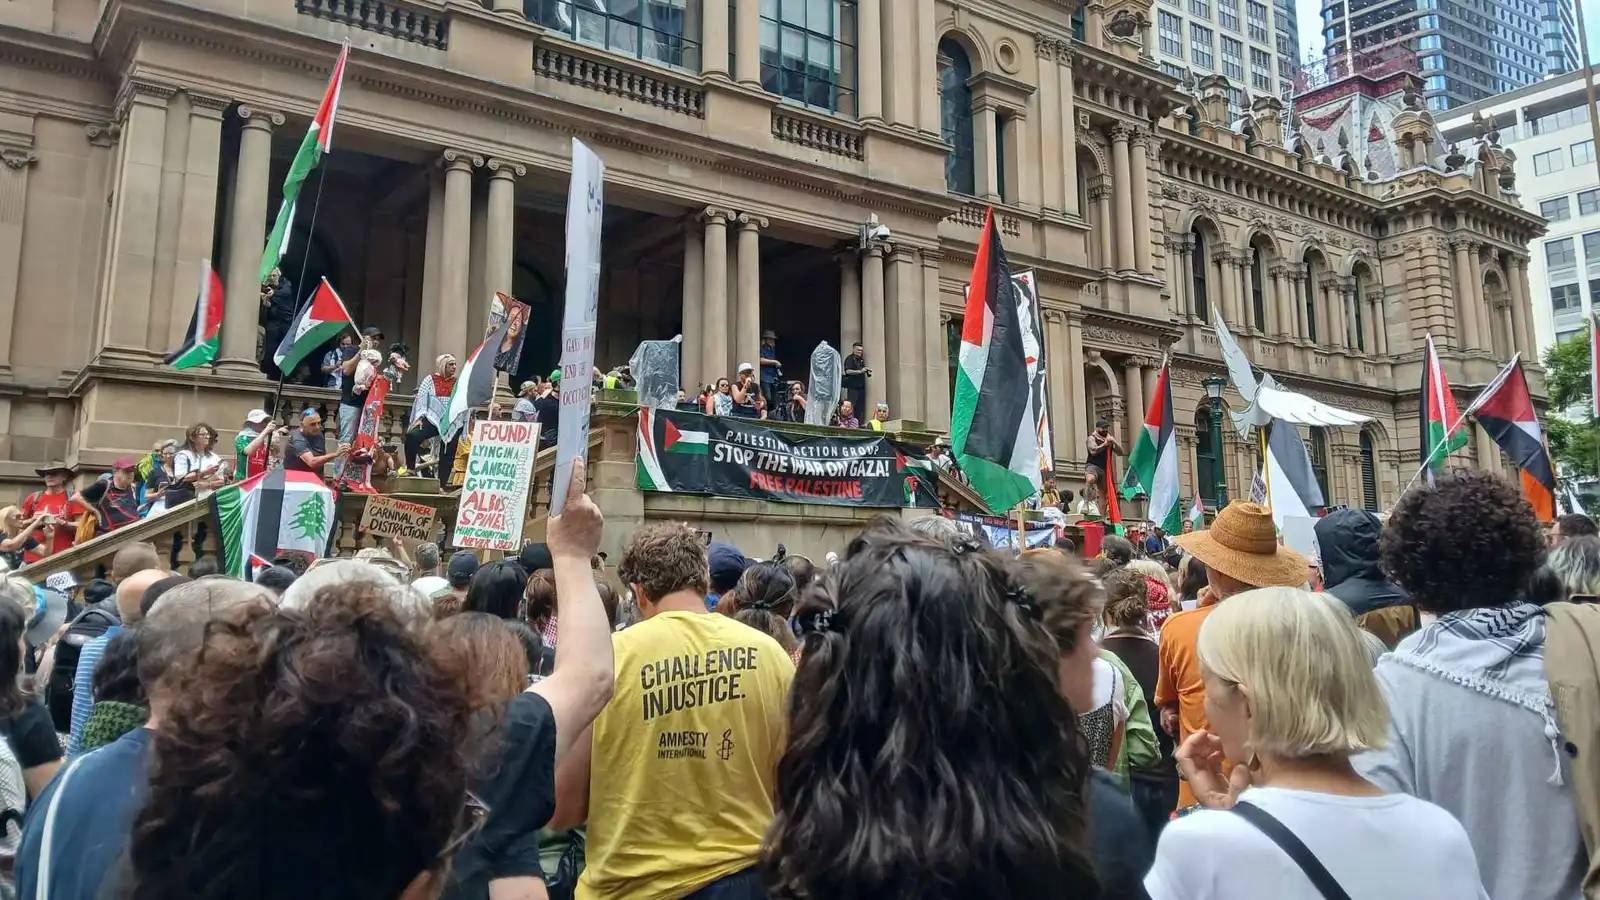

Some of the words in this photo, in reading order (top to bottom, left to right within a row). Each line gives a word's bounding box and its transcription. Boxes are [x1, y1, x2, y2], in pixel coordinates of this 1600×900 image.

[564, 363, 577, 379] END
[480, 424, 532, 444] FOUND!
[471, 445, 503, 458] LYING
[504, 447, 512, 459] IN
[713, 443, 751, 464] STOP
[756, 452, 788, 473] THE
[790, 458, 825, 476] WAR
[825, 460, 848, 477] ON
[850, 459, 890, 477] GAZA!
[793, 445, 838, 457] ACTION
[842, 444, 880, 457] GROUP
[465, 478, 515, 492] GUTTER
[750, 472, 782, 493] FREE
[785, 476, 863, 498] PALESTINE
[372, 496, 391, 505] JUST
[393, 501, 431, 515] ANOTHER
[369, 506, 413, 525] CARNIVAL
[416, 517, 431, 527] OF
[460, 509, 506, 530] SPINE!
[369, 518, 429, 541] DISTRACTION
[460, 536, 491, 549] NEVER
[493, 539, 518, 550] USED!
[640, 646, 758, 690] CHALLENGE
[643, 674, 746, 720] INJUSTICE.
[659, 731, 708, 747] AMNESTY
[658, 748, 707, 760] INTERNATIONAL
